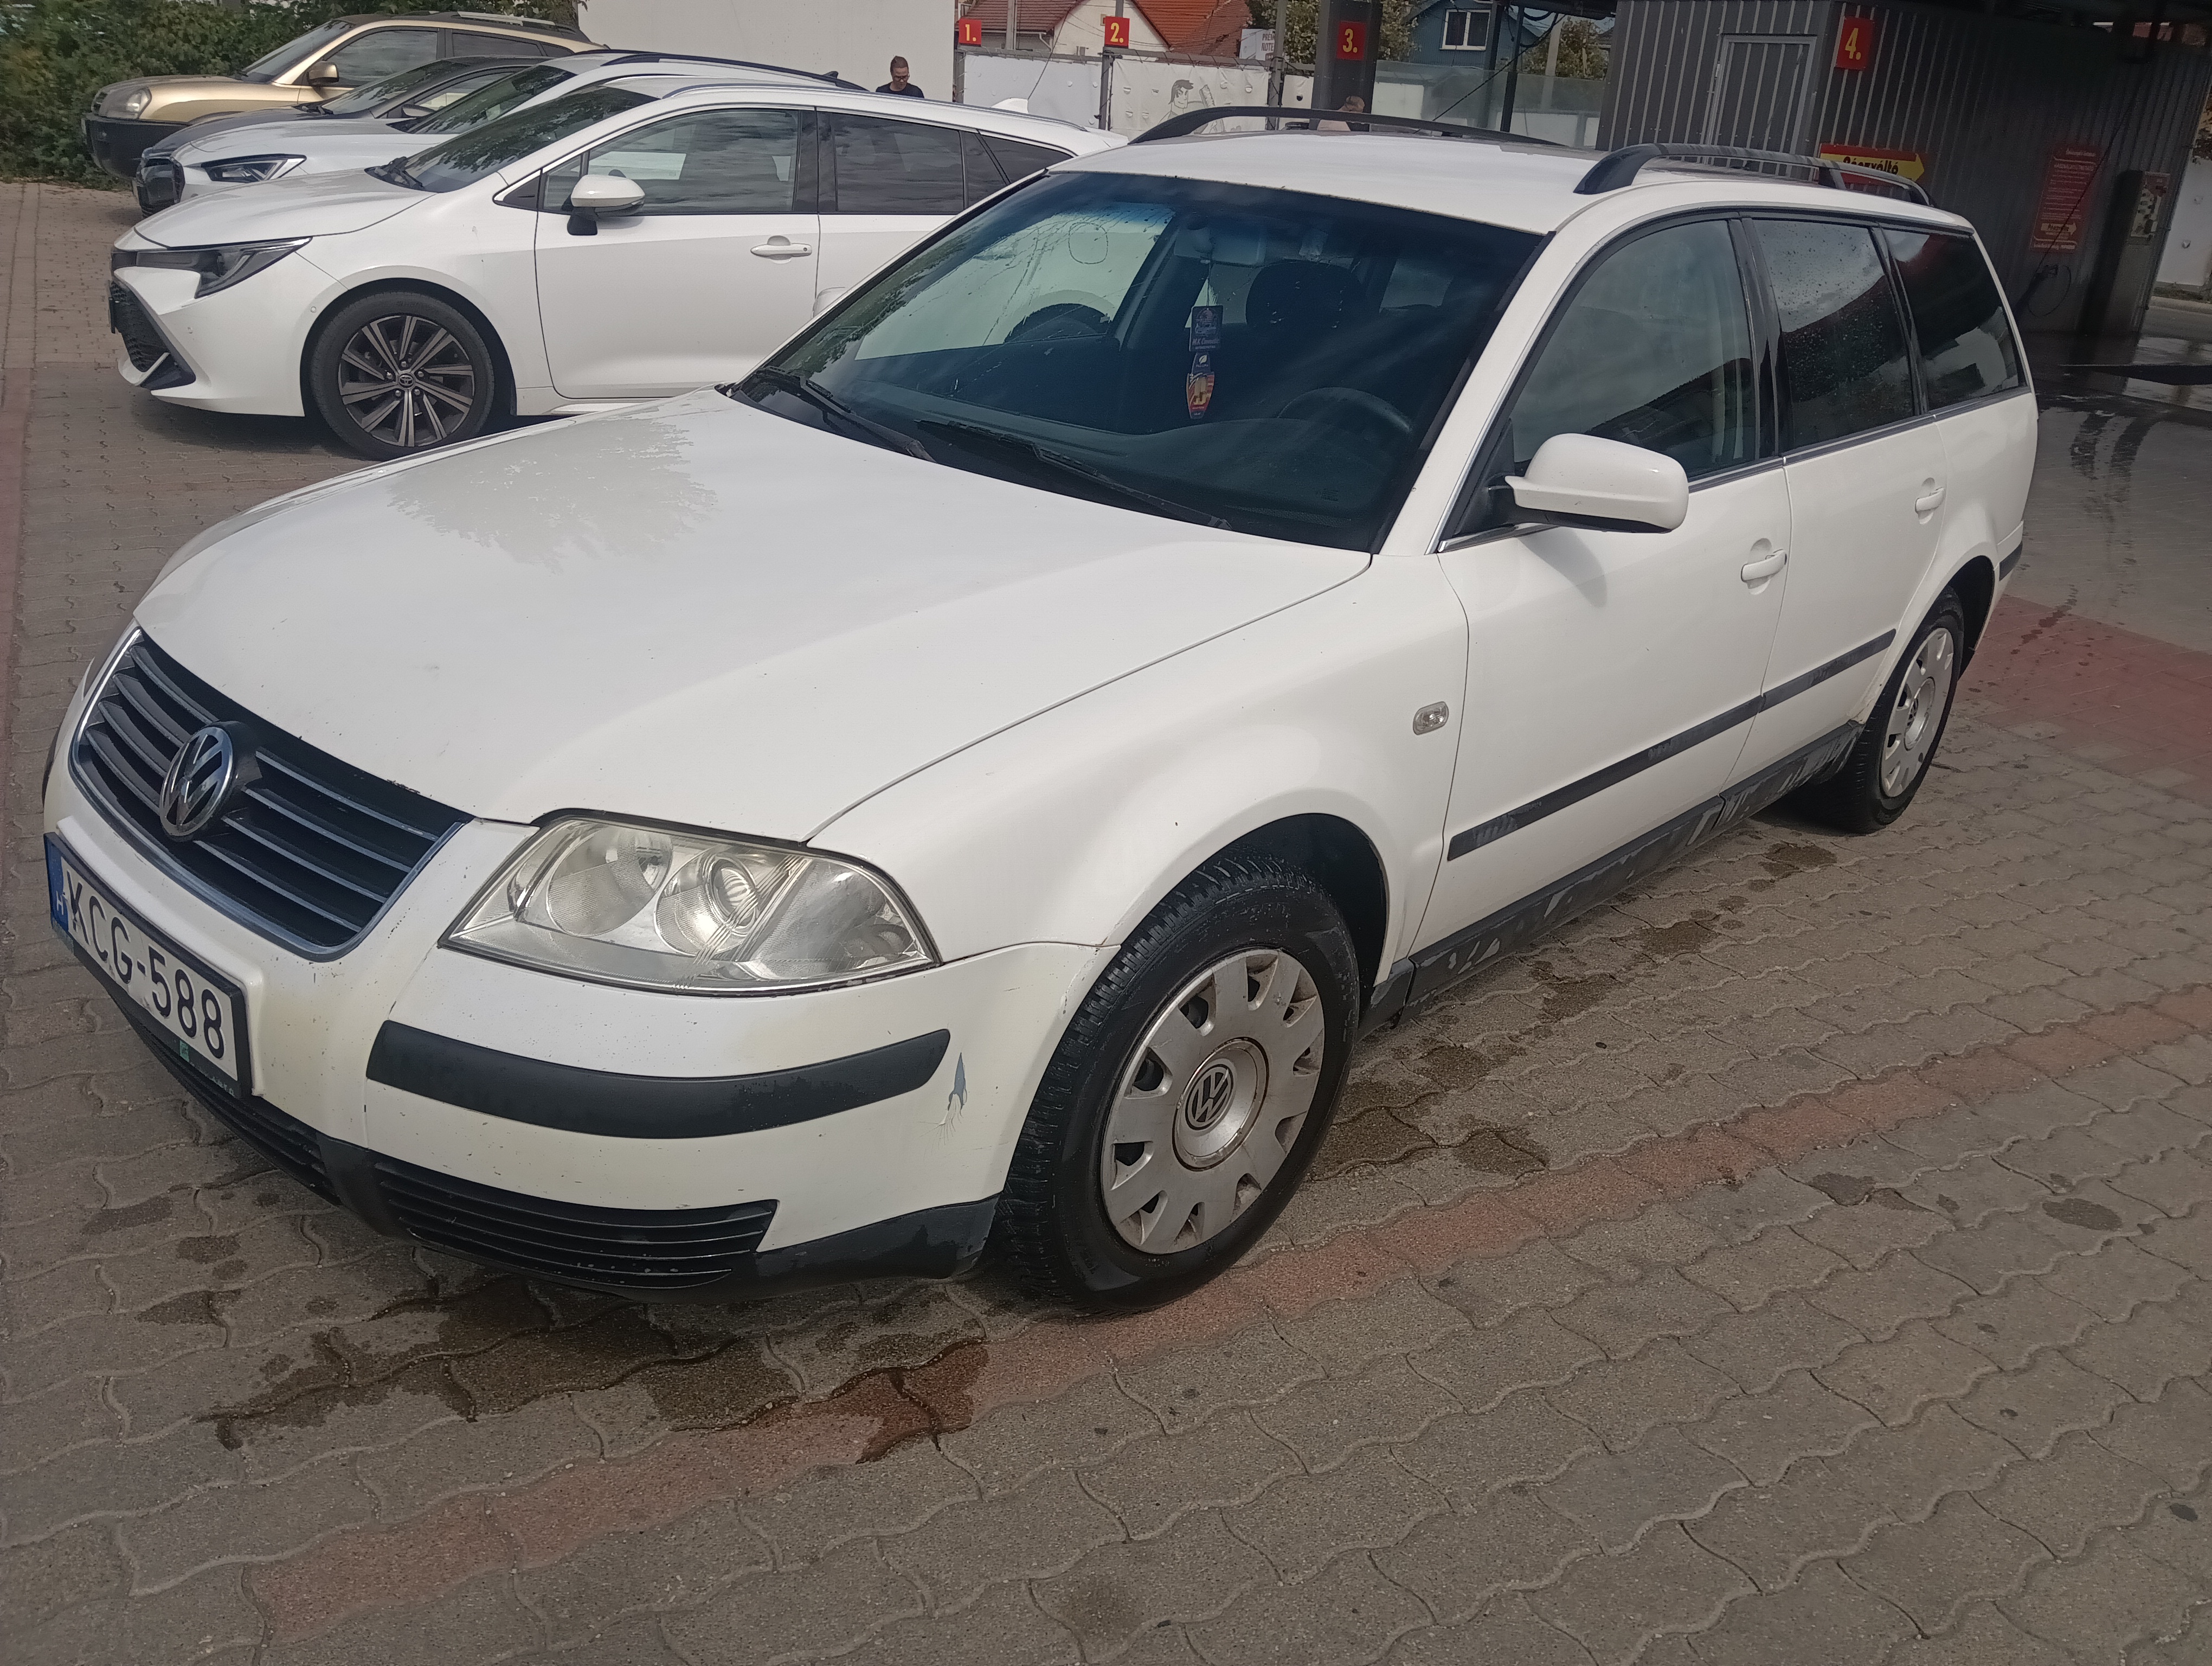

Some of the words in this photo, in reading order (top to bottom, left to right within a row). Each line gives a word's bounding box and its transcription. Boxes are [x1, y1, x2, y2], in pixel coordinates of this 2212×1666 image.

[965, 24, 976, 41] 1.
[1110, 23, 1123, 43] 2.
[1343, 29, 1358, 53] 3.
[1845, 28, 1861, 60] 4.
[56, 890, 64, 915] H
[67, 870, 224, 1059] KCG-588
